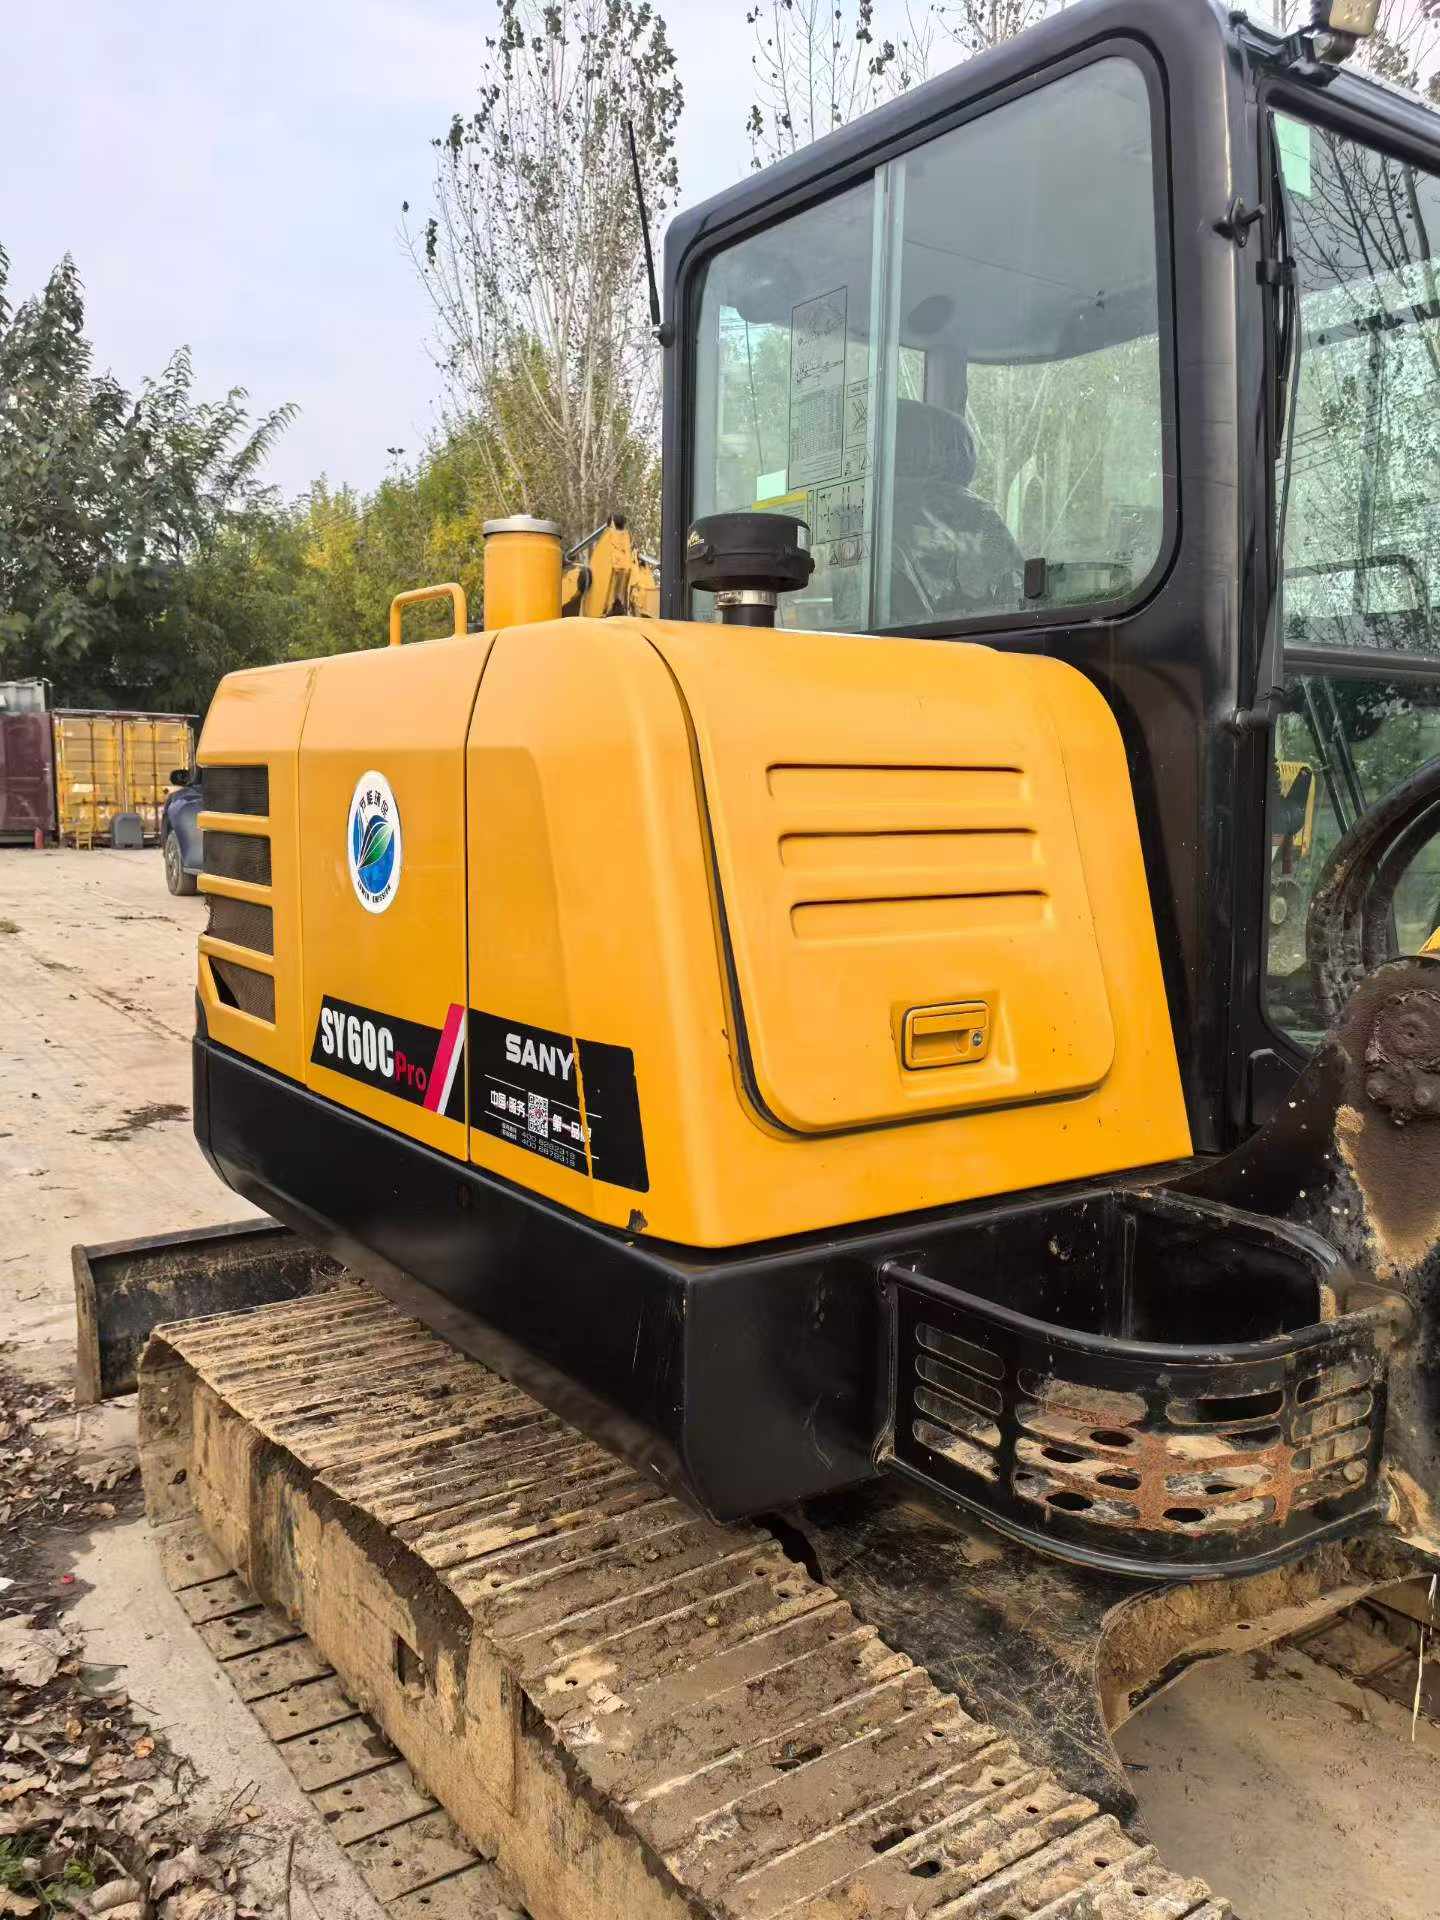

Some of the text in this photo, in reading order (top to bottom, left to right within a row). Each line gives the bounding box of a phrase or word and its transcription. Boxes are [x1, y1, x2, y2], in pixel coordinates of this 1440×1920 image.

[321, 1007, 427, 1091] SY60C Pro
[505, 1032, 575, 1081] SANY
